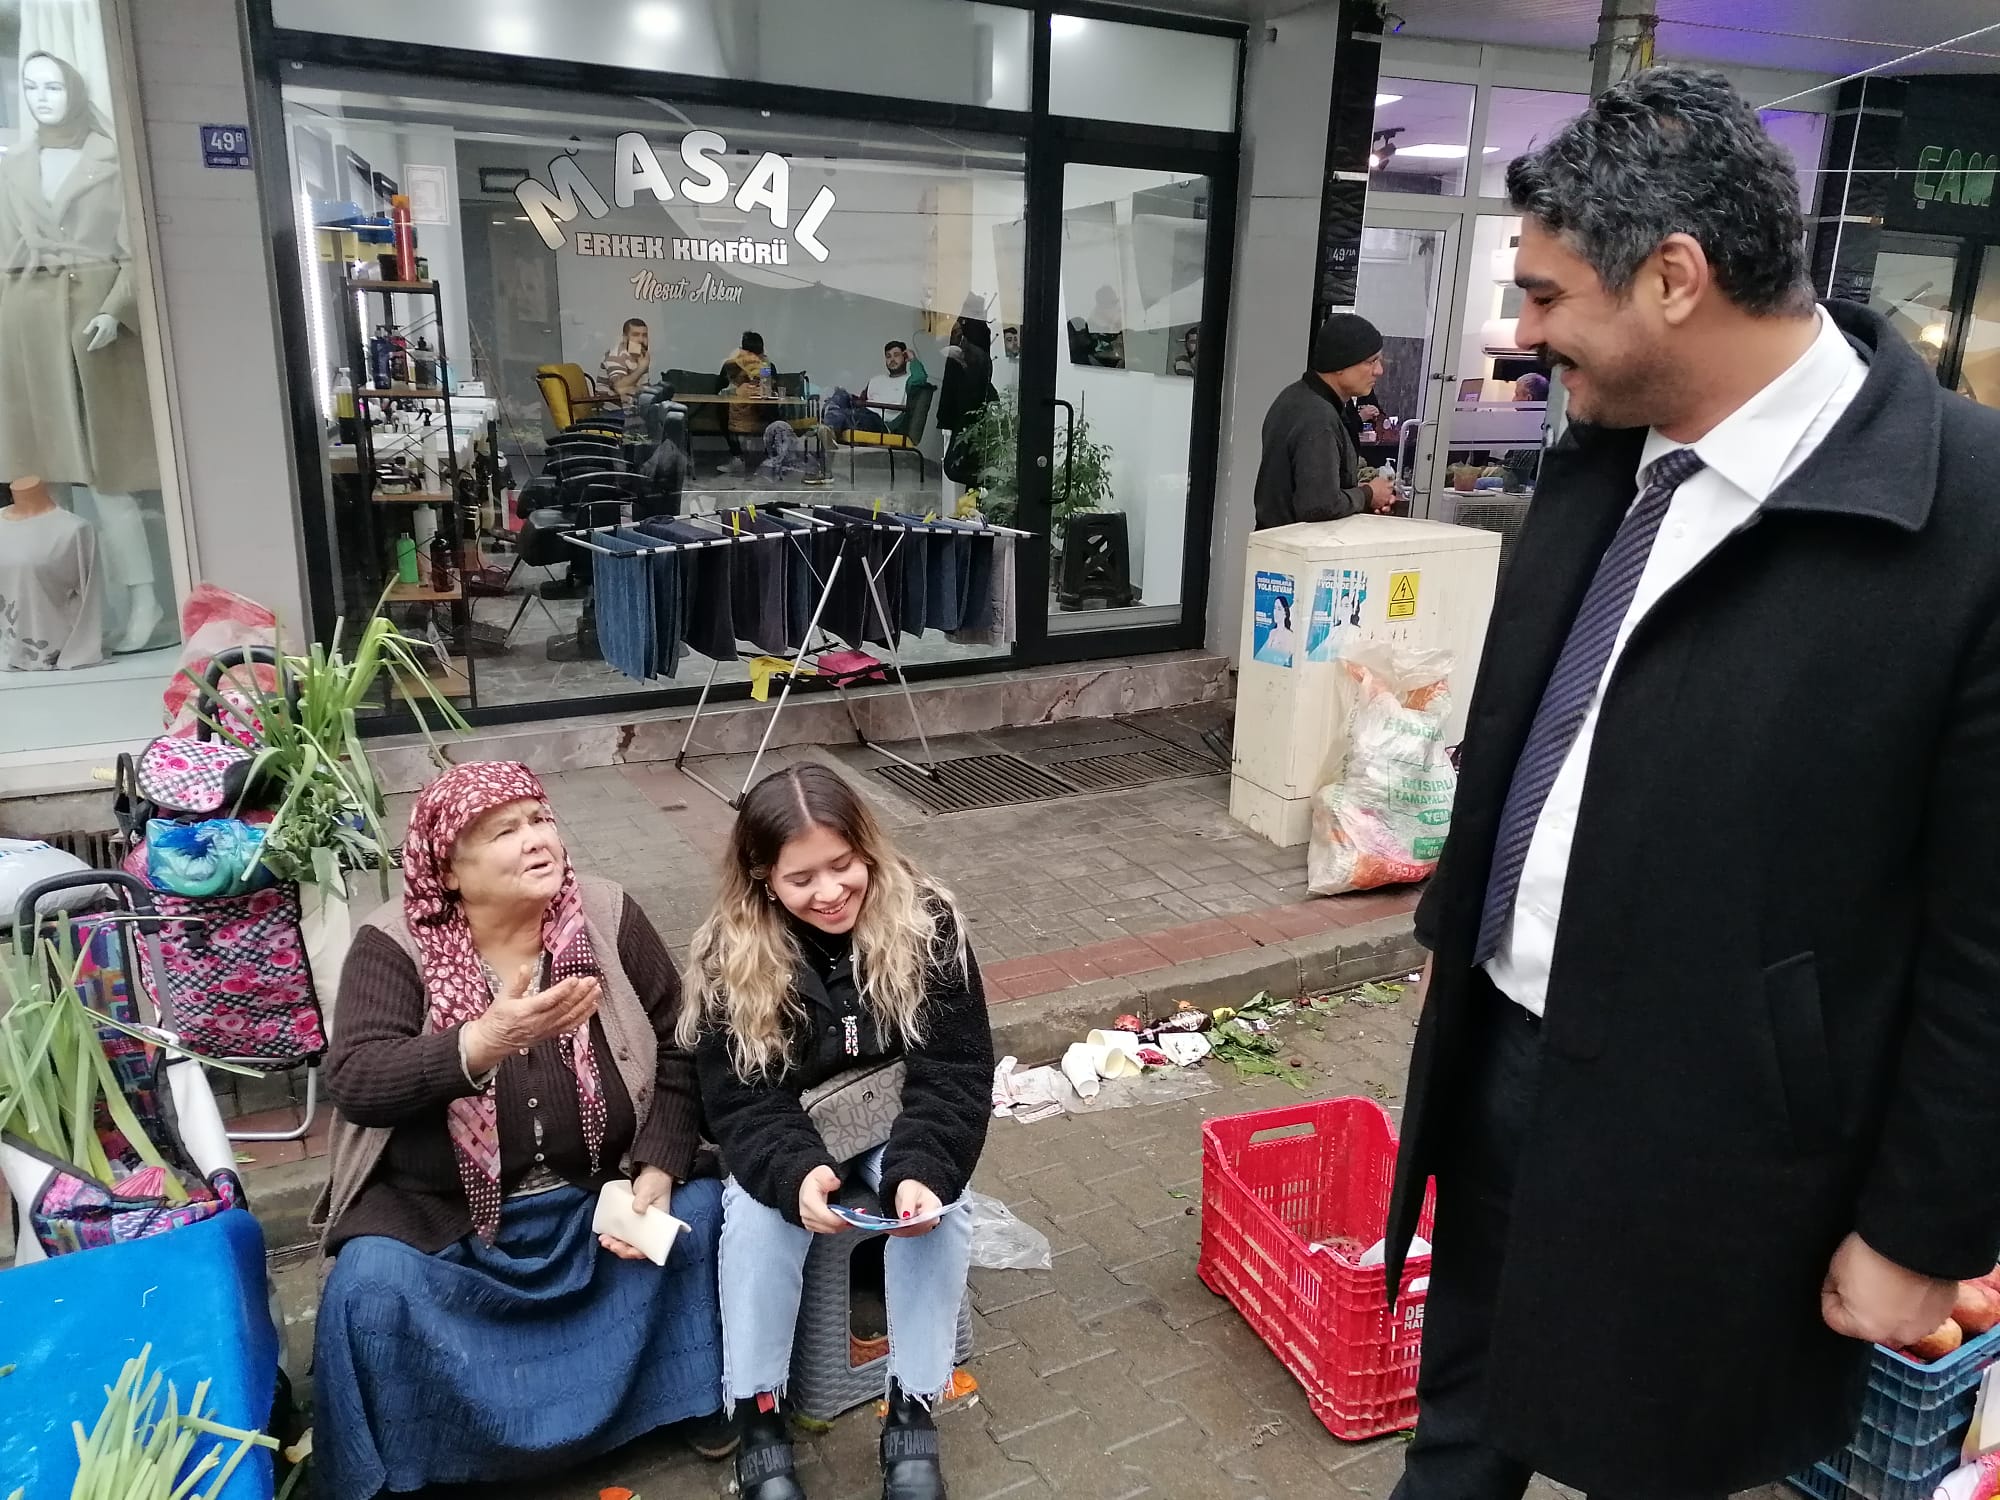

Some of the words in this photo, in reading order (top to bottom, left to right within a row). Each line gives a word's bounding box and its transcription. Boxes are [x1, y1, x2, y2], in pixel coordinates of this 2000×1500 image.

[513, 129, 836, 263] MASAL
[575, 232, 665, 260] ERKEK
[672, 236, 789, 265] KUAFÖRÜ
